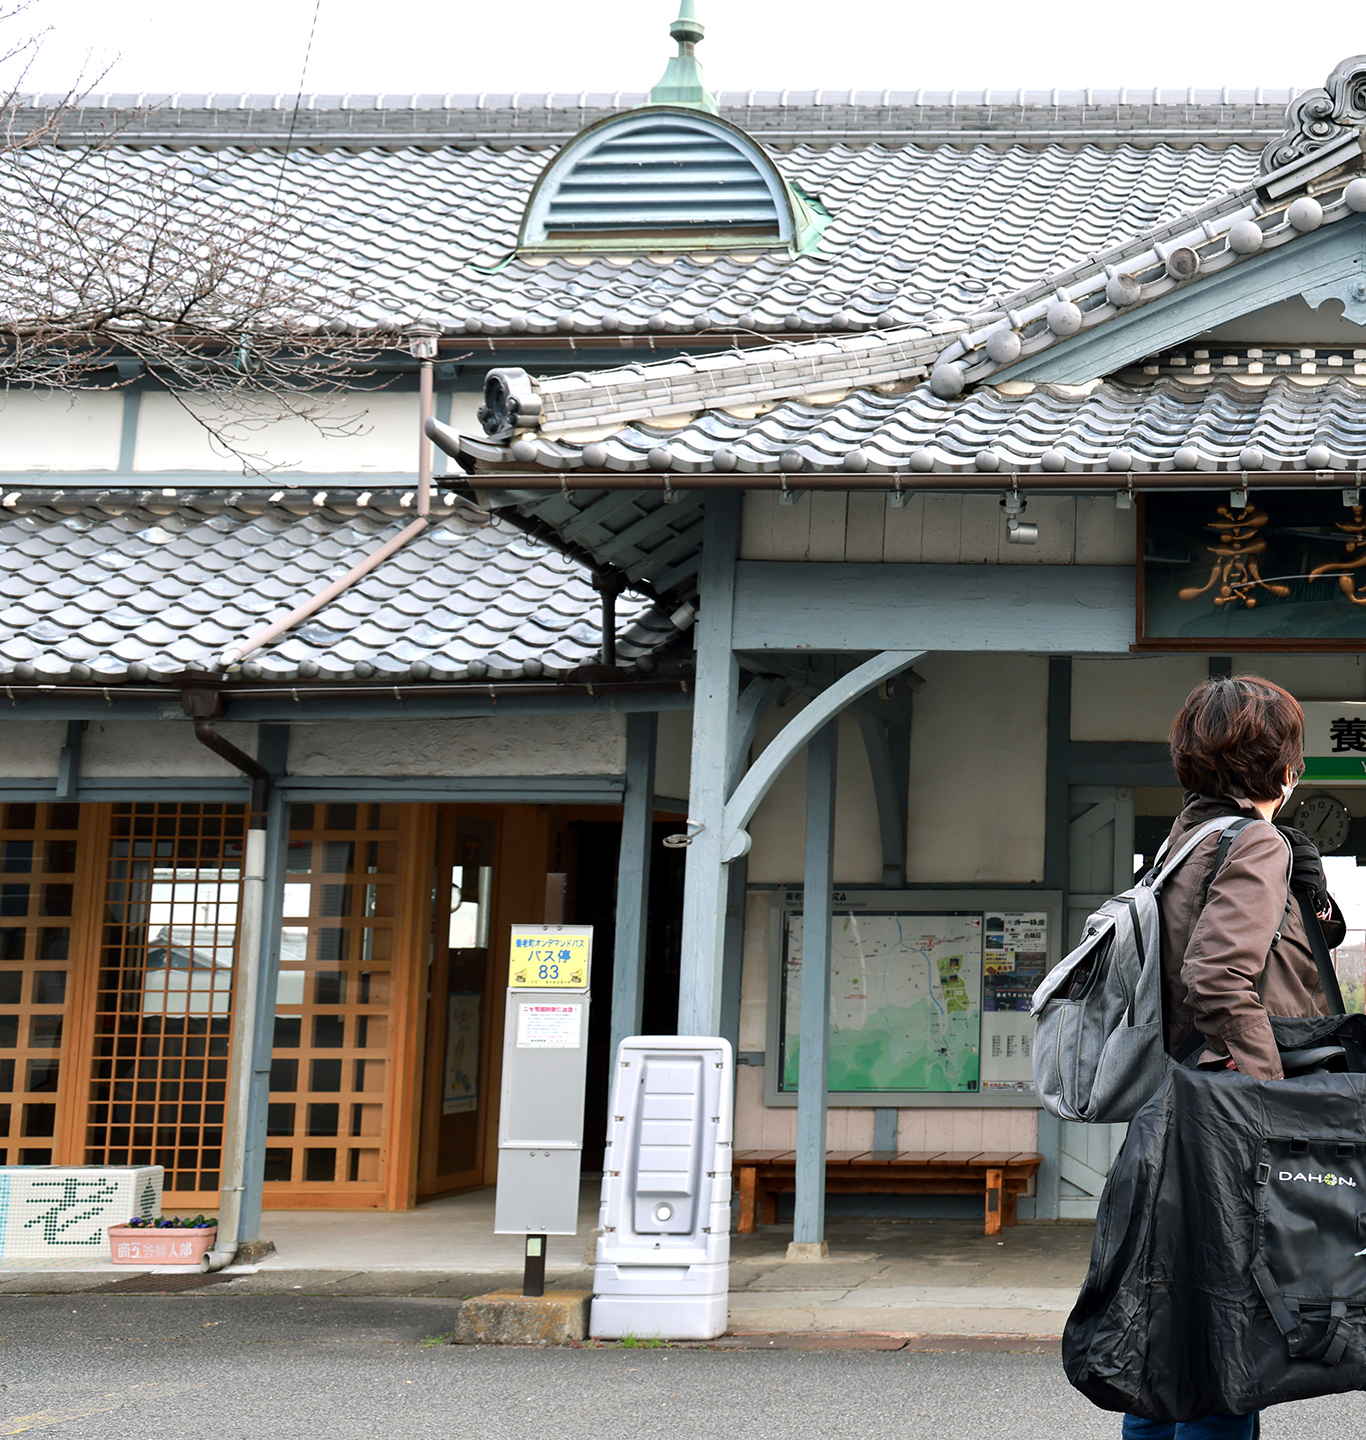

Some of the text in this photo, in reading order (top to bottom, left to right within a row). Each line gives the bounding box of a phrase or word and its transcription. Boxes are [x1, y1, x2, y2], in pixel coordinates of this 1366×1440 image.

[1318, 801, 1325, 809] 12
[516, 939, 585, 948] 養老町オンデマンドバス
[528, 949, 571, 963] バス停
[538, 965, 559, 979] 83
[1279, 1171, 1354, 1186] DAHON
[24, 1178, 118, 1245] 老
[117, 1242, 193, 1258] 商工会婦人部
